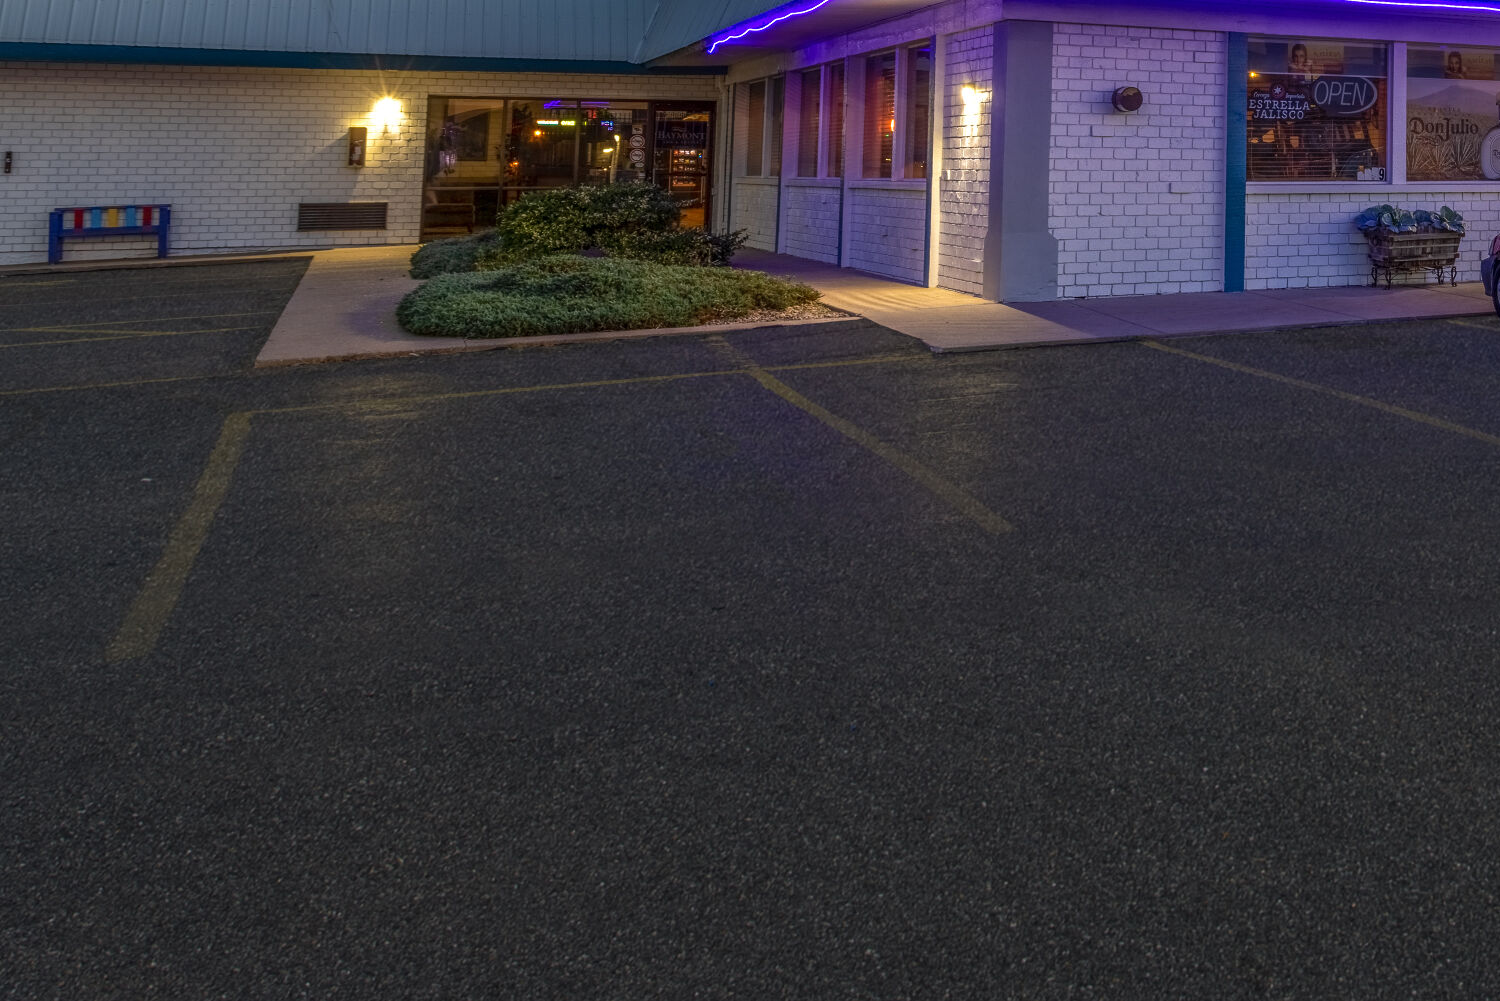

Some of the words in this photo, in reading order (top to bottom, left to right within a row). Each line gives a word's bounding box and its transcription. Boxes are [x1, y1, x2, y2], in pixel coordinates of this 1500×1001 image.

[1314, 79, 1368, 106] OPEN
[1248, 99, 1311, 111] ESTRELLA
[1253, 109, 1305, 120] JALISCO
